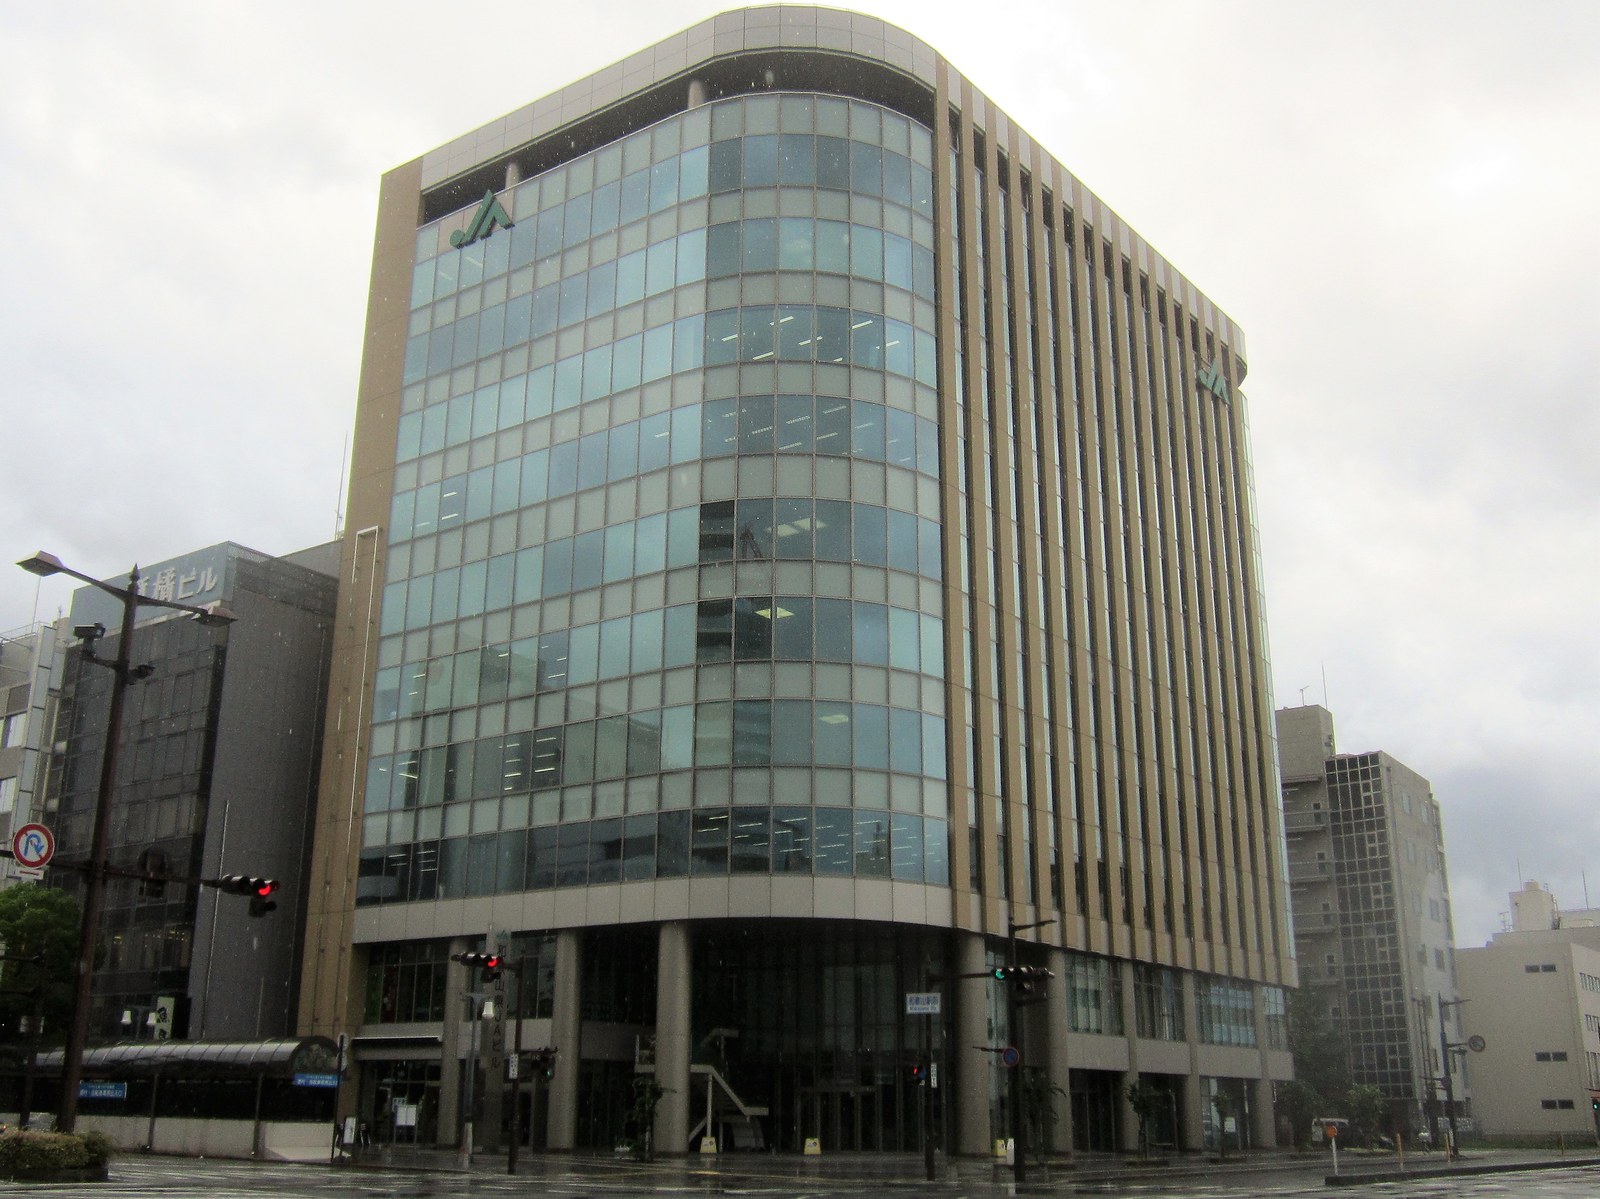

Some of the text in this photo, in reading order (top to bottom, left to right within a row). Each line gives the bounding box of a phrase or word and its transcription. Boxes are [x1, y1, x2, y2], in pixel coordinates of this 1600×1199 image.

[449, 189, 515, 249] JA
[490, 945, 507, 1070] 和山県JAビル
